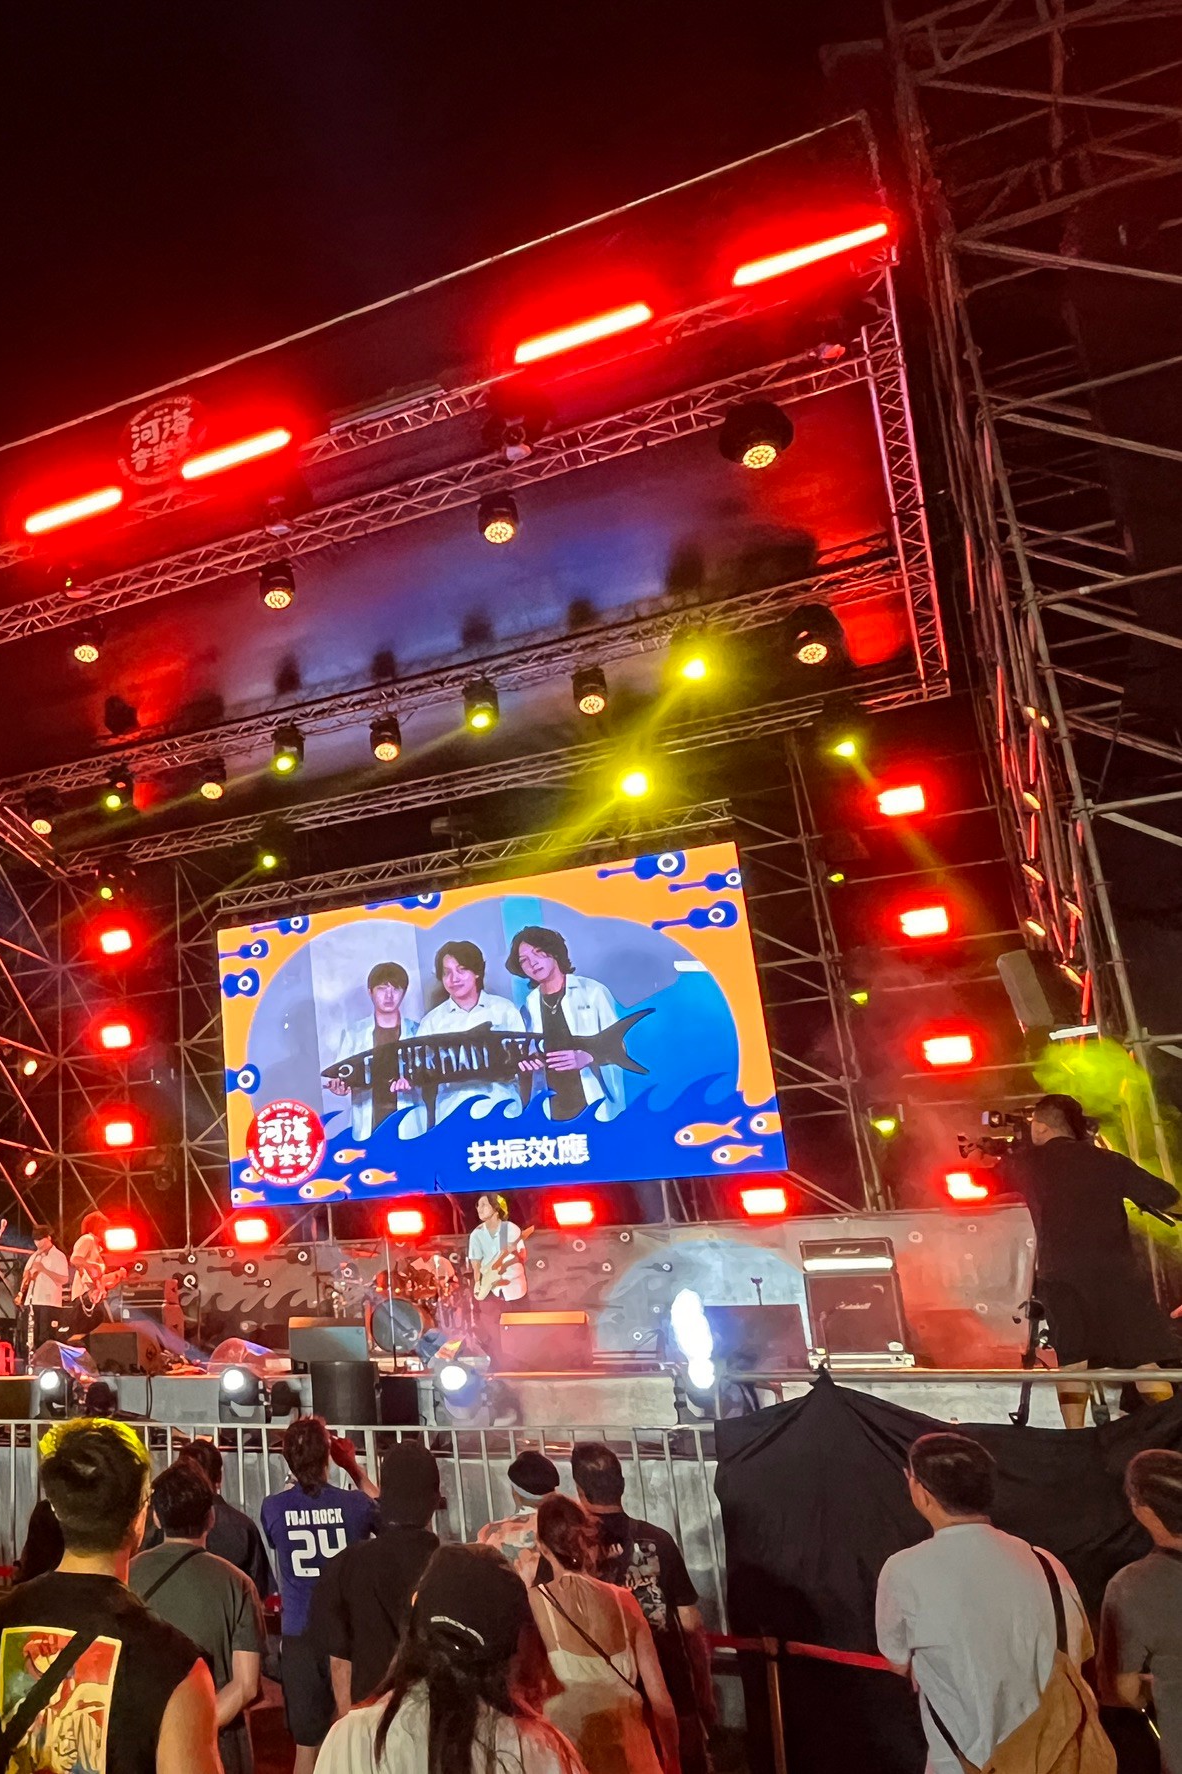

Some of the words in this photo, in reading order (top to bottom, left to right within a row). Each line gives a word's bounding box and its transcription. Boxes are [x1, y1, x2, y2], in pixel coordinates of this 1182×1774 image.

[467, 1133, 590, 1172] 共振效應
[285, 1509, 311, 1526] FUJI
[311, 1507, 344, 1525] ROCK
[288, 1528, 347, 1577] 24
